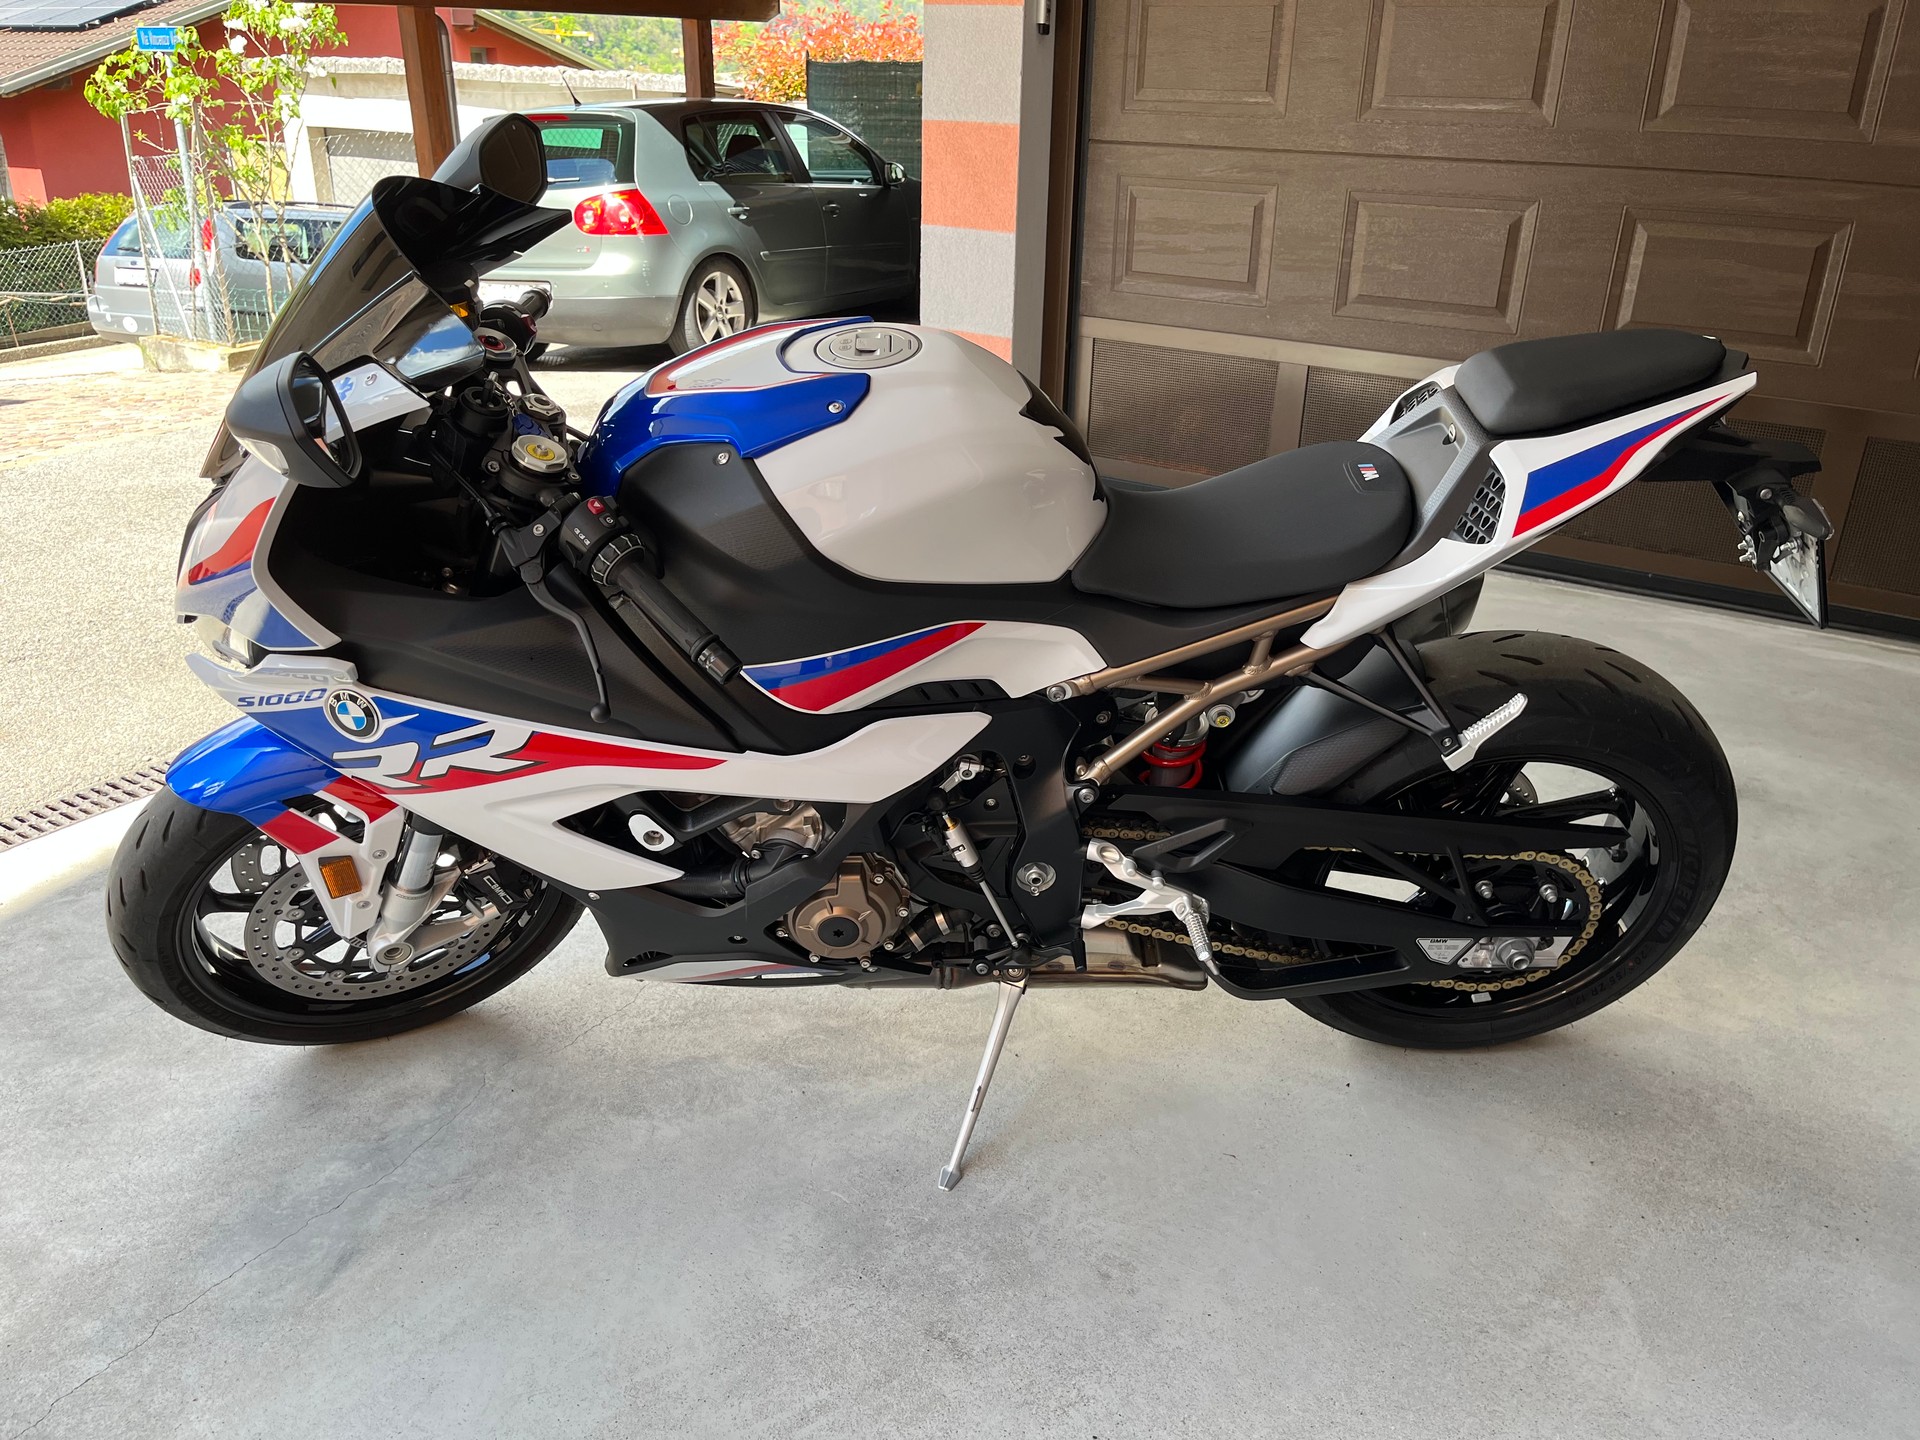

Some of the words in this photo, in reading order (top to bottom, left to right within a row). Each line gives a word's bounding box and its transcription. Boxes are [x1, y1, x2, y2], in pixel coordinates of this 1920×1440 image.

[237, 688, 328, 707] S1000
[329, 692, 368, 709] BMW
[332, 728, 548, 789] RR
